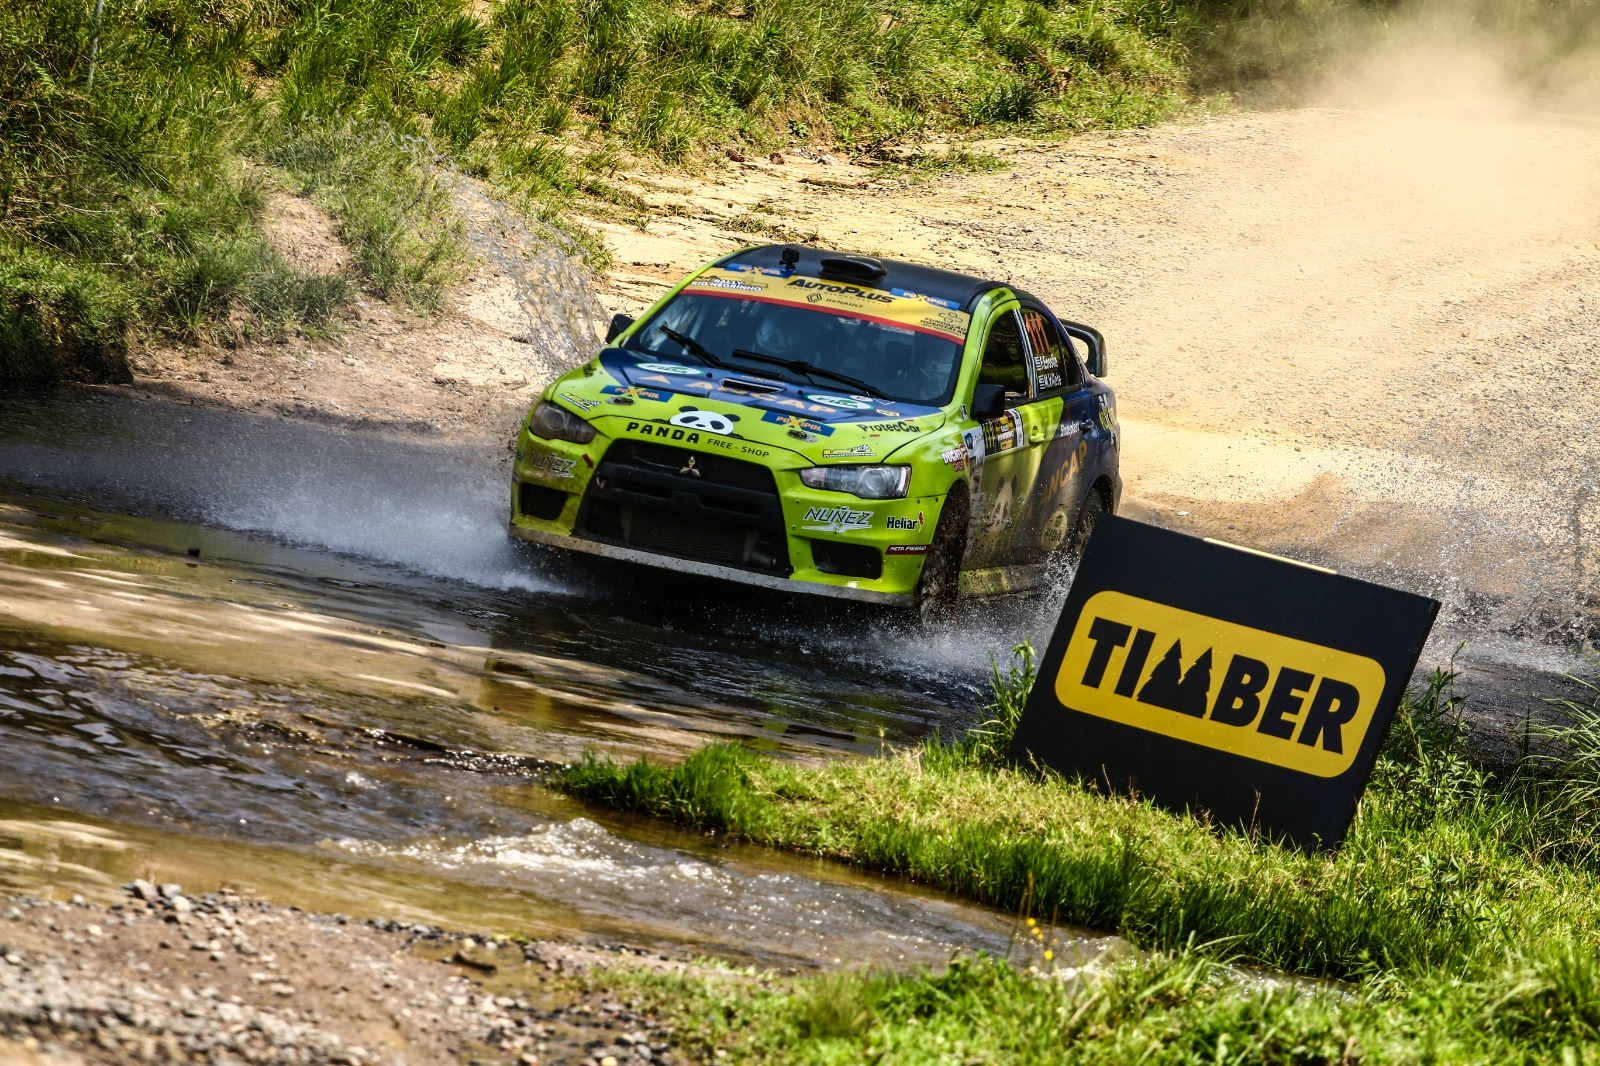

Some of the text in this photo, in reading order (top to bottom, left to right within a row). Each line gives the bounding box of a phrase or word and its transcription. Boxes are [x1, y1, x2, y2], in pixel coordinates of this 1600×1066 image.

[710, 281, 763, 293] NEGRINHO
[713, 278, 744, 287] RALLY
[825, 298, 864, 309] RENAULT
[857, 421, 921, 433] ProtecCar
[626, 421, 700, 445] PANDA
[707, 438, 733, 450] FREE
[741, 446, 770, 458] SHOP
[803, 505, 875, 526] NUÑEZ
[885, 515, 918, 531] Heliar
[1080, 615, 1362, 756] TIMBER
